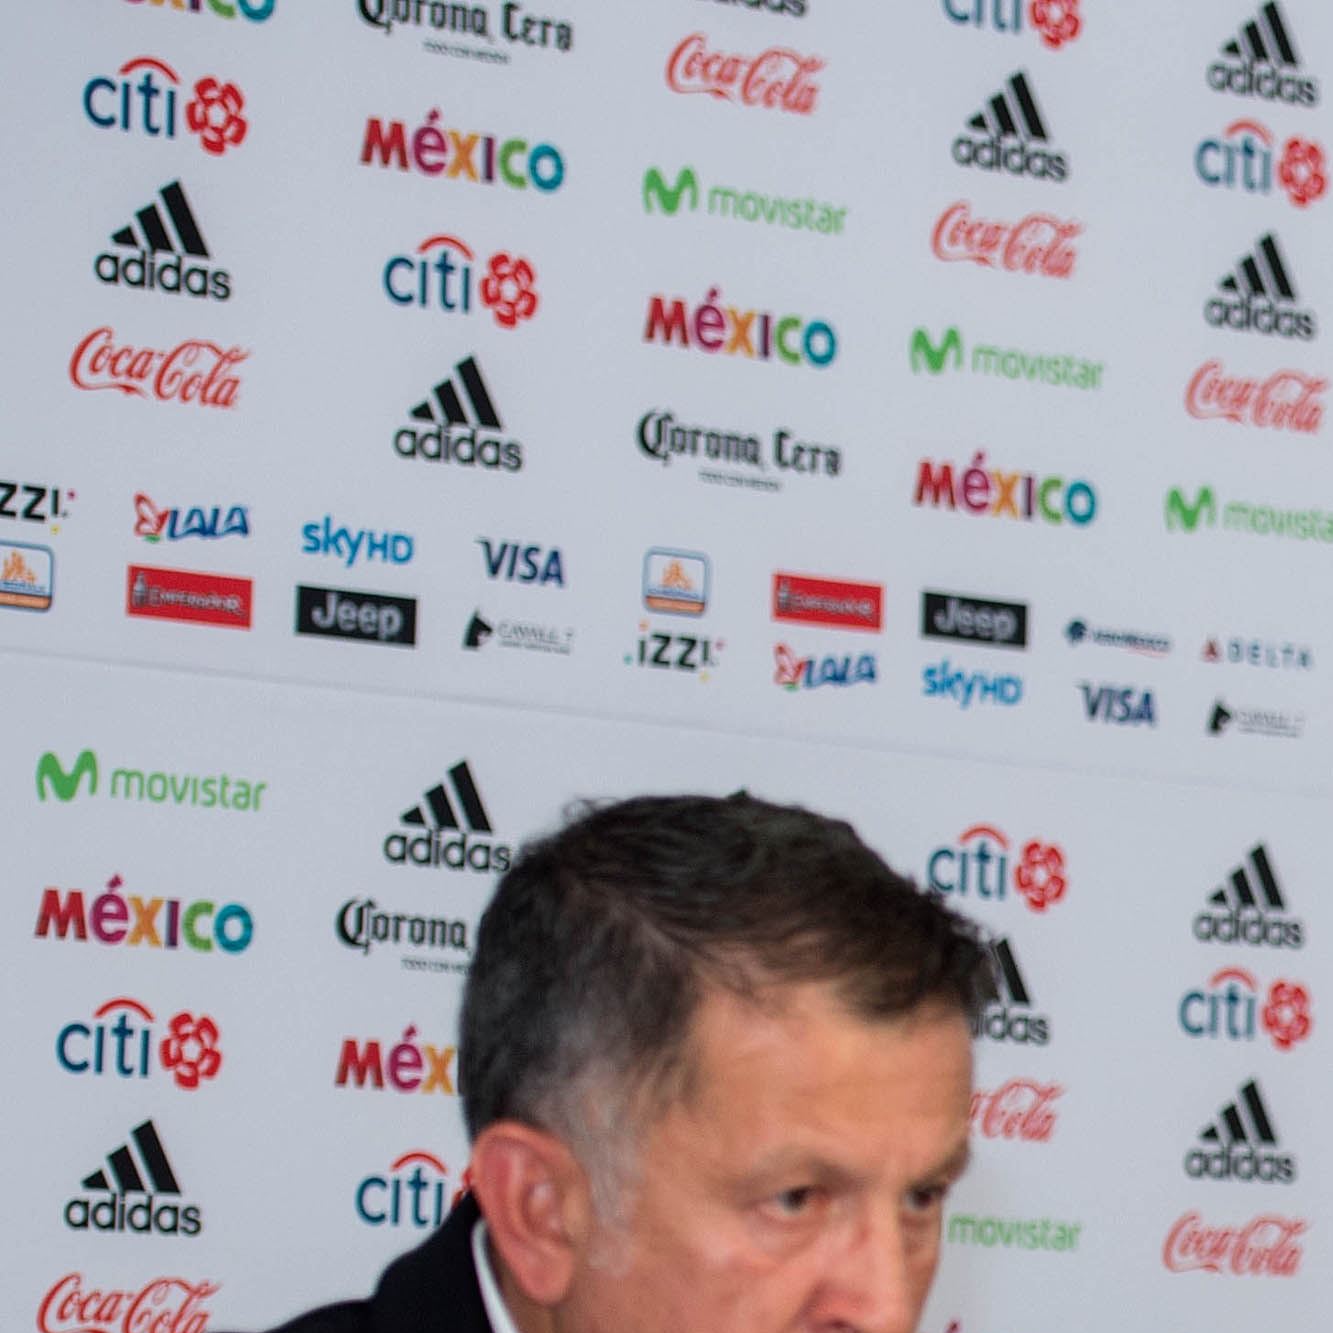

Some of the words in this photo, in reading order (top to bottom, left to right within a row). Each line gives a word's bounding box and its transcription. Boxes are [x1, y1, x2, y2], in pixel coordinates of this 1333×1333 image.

[666, 33, 823, 114] Coca-Cola
[1210, 59, 1315, 105] adidas
[82, 72, 175, 138] citi
[954, 134, 1067, 181] adidas
[1196, 137, 1270, 188] citi
[708, 186, 847, 234] movistar
[931, 202, 1081, 278] Coca-Cola
[94, 248, 231, 301] adidas
[382, 250, 470, 312] citi
[1208, 291, 1313, 336] adidas
[69, 327, 248, 408] Coca-Cola
[972, 345, 1103, 389] movistar
[1185, 361, 1328, 433] Coca-Cola
[394, 421, 522, 471] adidas
[635, 409, 764, 467] Corona
[479, 540, 564, 587] VISA
[311, 592, 403, 638] Jeep
[933, 597, 1018, 641] Jeep
[1081, 684, 1156, 725] VISA
[110, 768, 267, 811] movistar
[383, 826, 511, 873] adidas
[335, 899, 469, 955] Corona
[1196, 903, 1302, 948] adidas
[973, 1003, 1048, 1044] idas
[1180, 986, 1254, 1037] citi
[56, 1013, 149, 1078] citi
[335, 1024, 456, 1096] Méx
[1186, 1138, 1294, 1182] adidas
[64, 1185, 202, 1236] adidas
[355, 1166, 445, 1227] citi
[945, 1214, 1081, 1253] movistar
[1163, 1212, 1306, 1276] Coca-Cola
